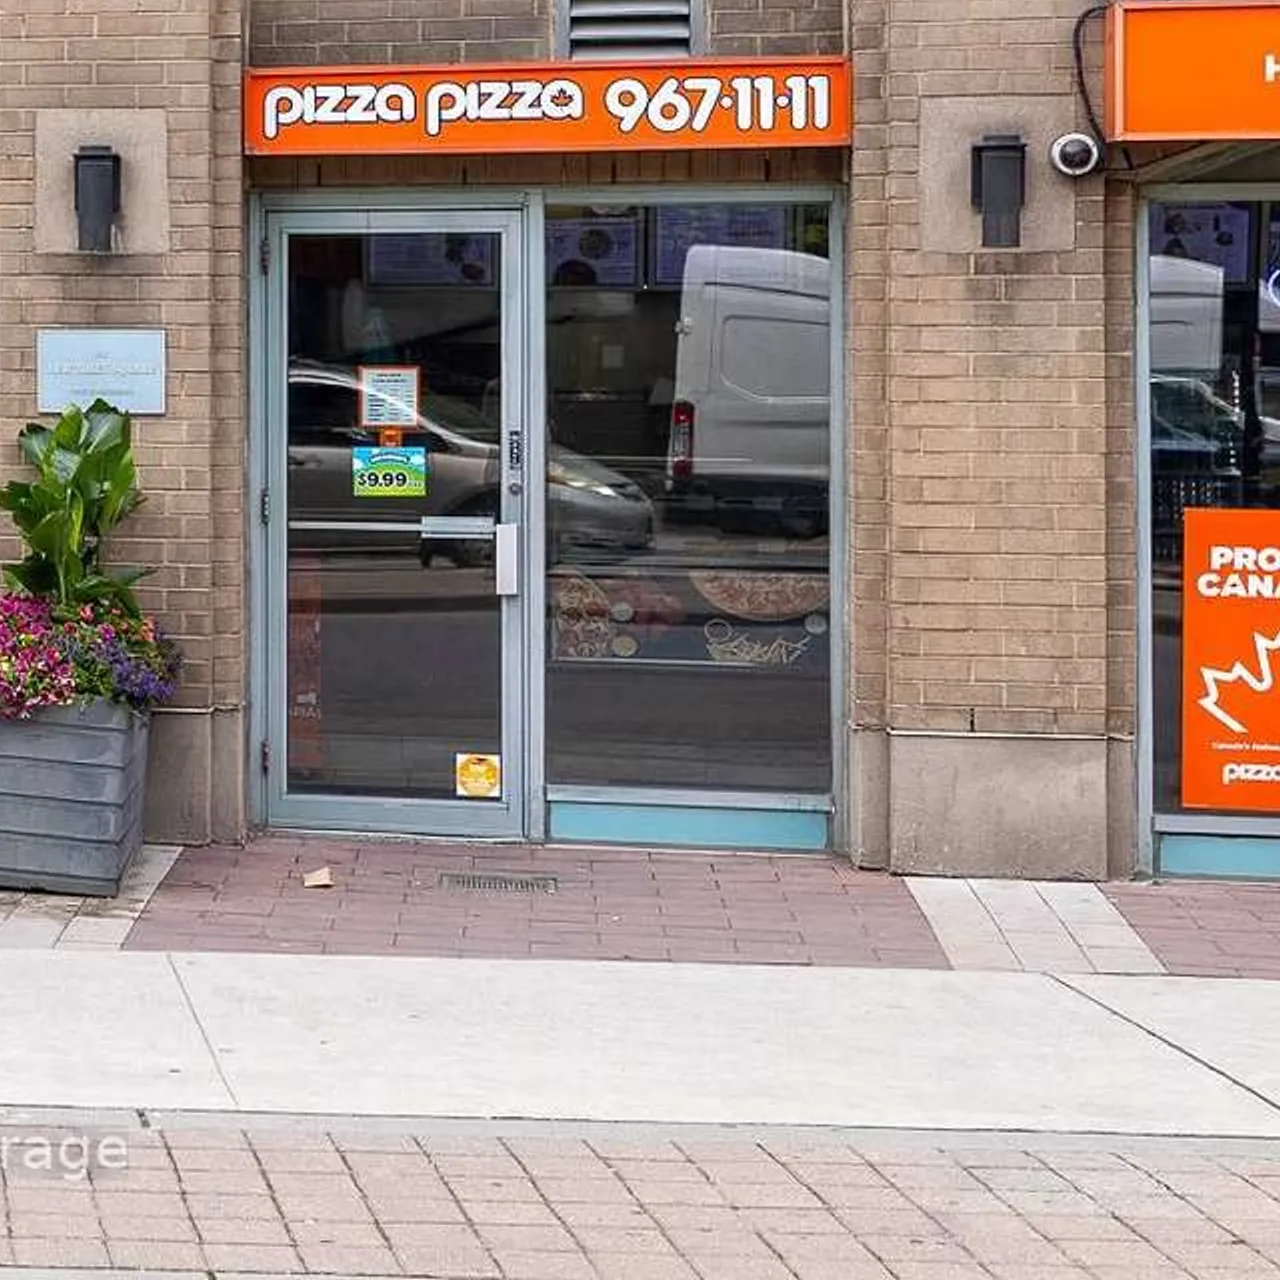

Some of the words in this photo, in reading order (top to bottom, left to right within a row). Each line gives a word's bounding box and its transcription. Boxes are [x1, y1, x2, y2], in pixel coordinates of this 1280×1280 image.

[263, 82, 417, 139] pizza
[425, 79, 585, 137] pizza
[358, 472, 407, 487] $9.99
[1210, 546, 1280, 571] PRO
[1197, 573, 1280, 597] CAN
